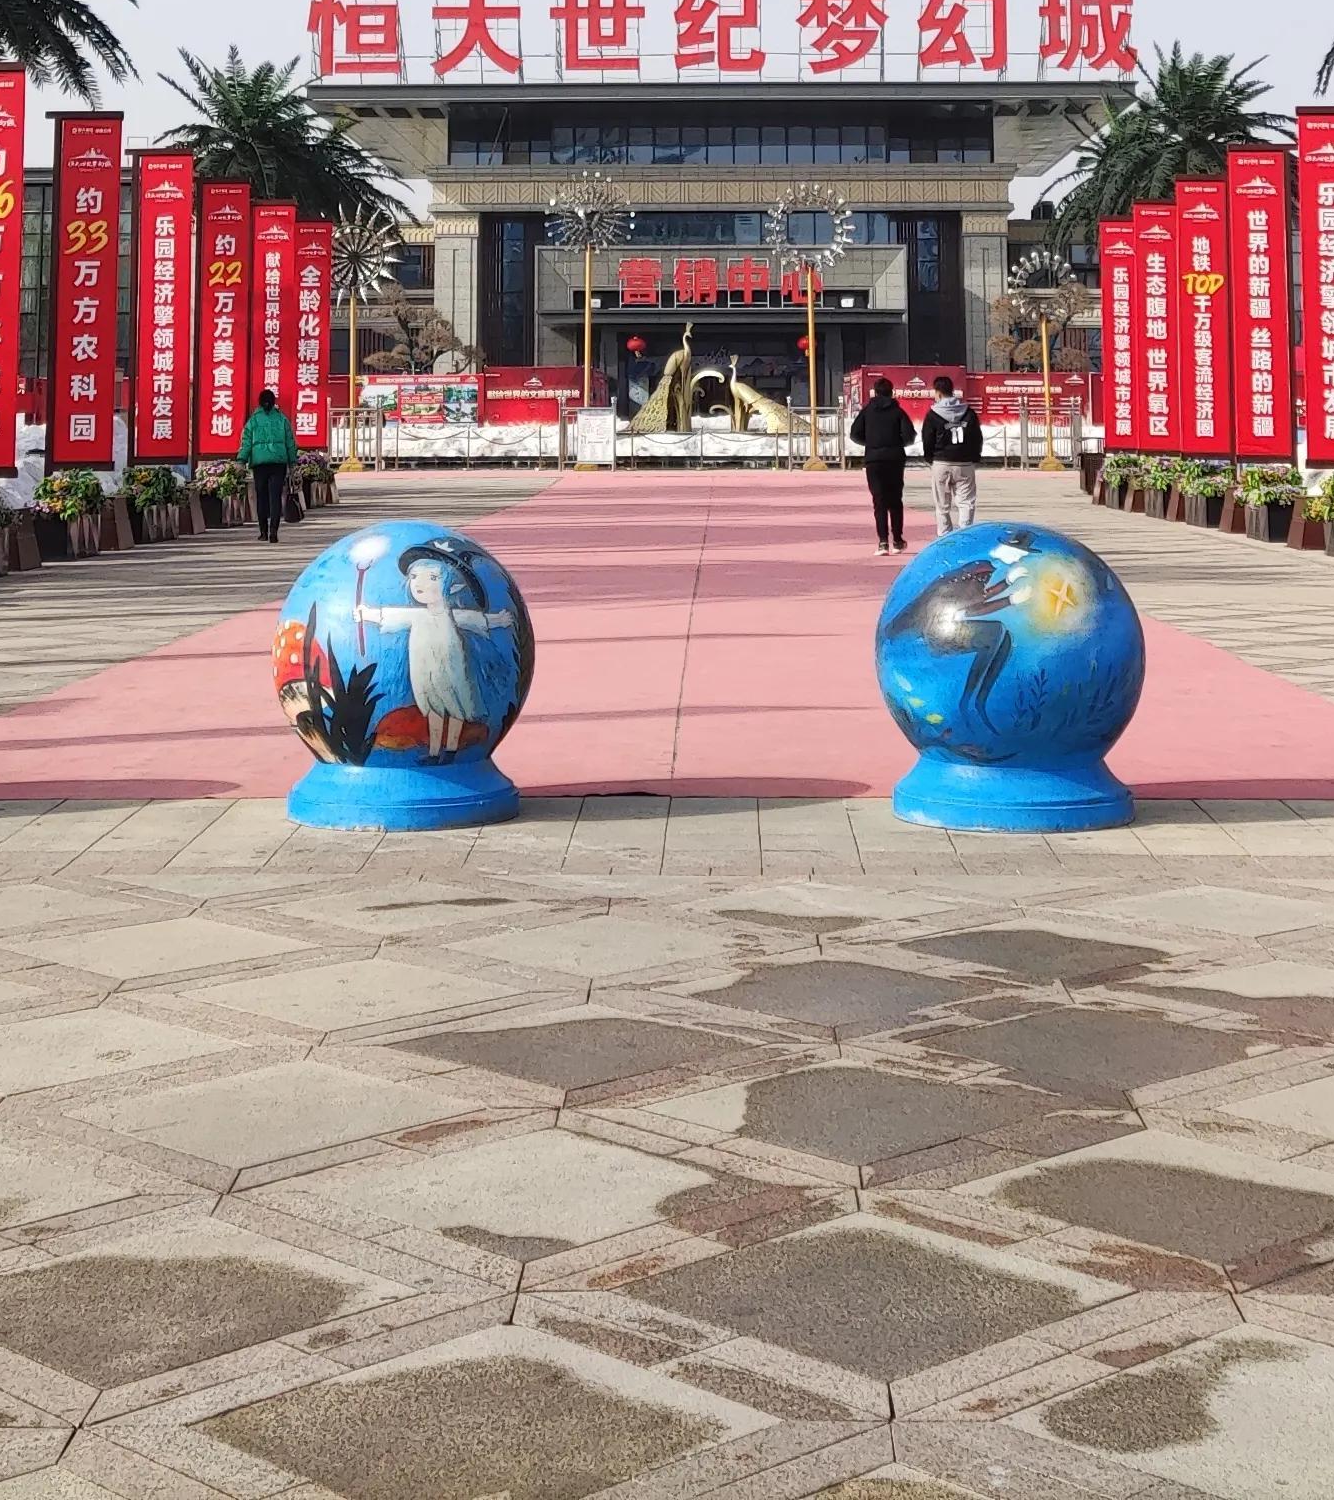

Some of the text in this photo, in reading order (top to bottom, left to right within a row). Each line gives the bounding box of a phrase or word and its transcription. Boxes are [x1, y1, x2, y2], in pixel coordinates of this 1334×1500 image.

[65, 187, 108, 441] 约33万方农科园
[153, 216, 175, 439] 乐园经济擎领城市发展
[619, 258, 822, 304] 营销中心
[1146, 253, 1167, 339] 生态腹地
[1247, 210, 1271, 318] 世界的新疆
[209, 235, 242, 437] 约22万方美食天地
[296, 265, 320, 435] 全龄化精装户型
[1147, 349, 1169, 435] 世界氧区
[1182, 236, 1224, 437] 地铁TOD千万级客流经济圈
[1251, 328, 1274, 436] 丝路的新疆
